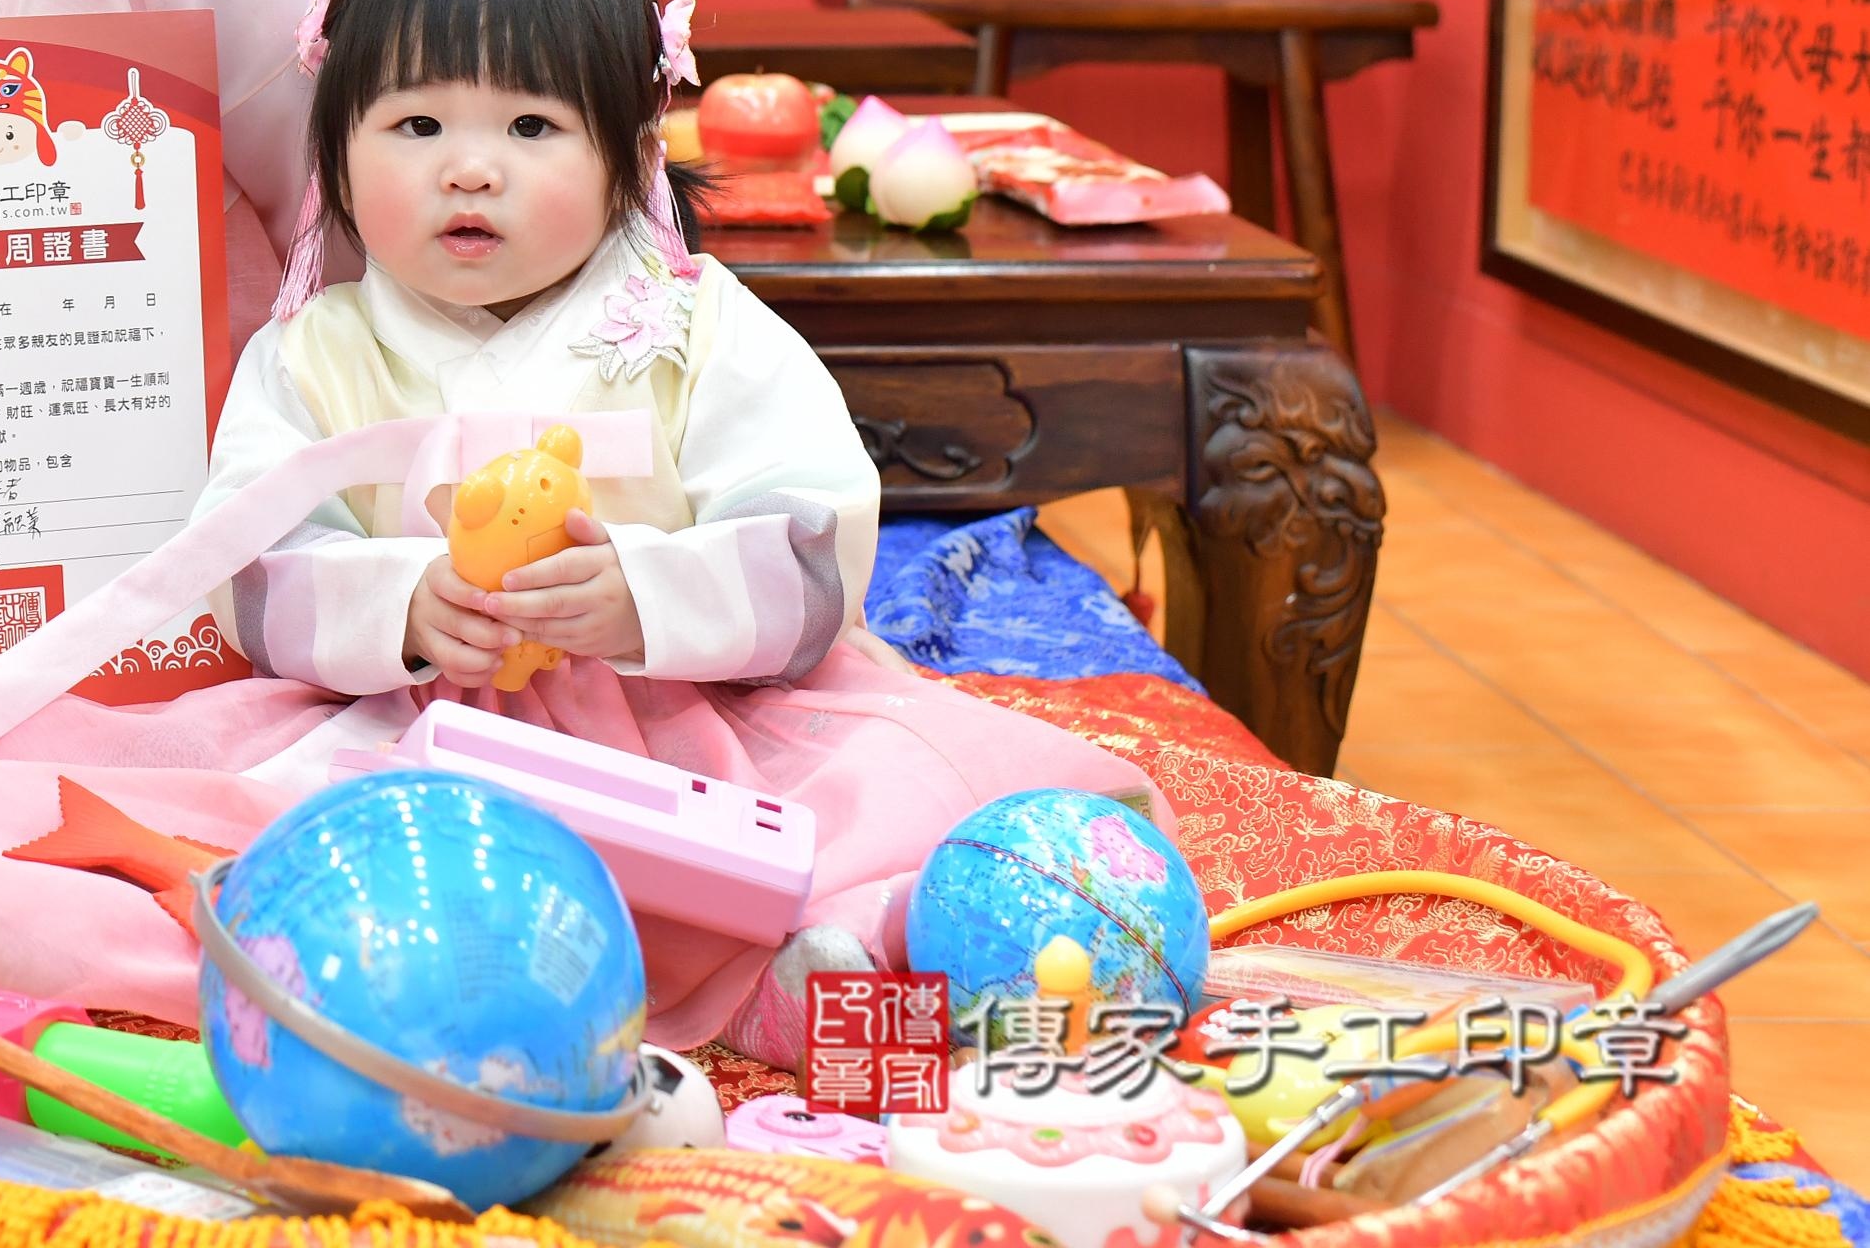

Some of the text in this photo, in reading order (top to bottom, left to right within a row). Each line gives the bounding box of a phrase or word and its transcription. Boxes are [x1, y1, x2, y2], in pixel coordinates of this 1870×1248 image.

[62, 299, 75, 312] 年
[104, 295, 116, 309] 月
[146, 293, 156, 306] 日
